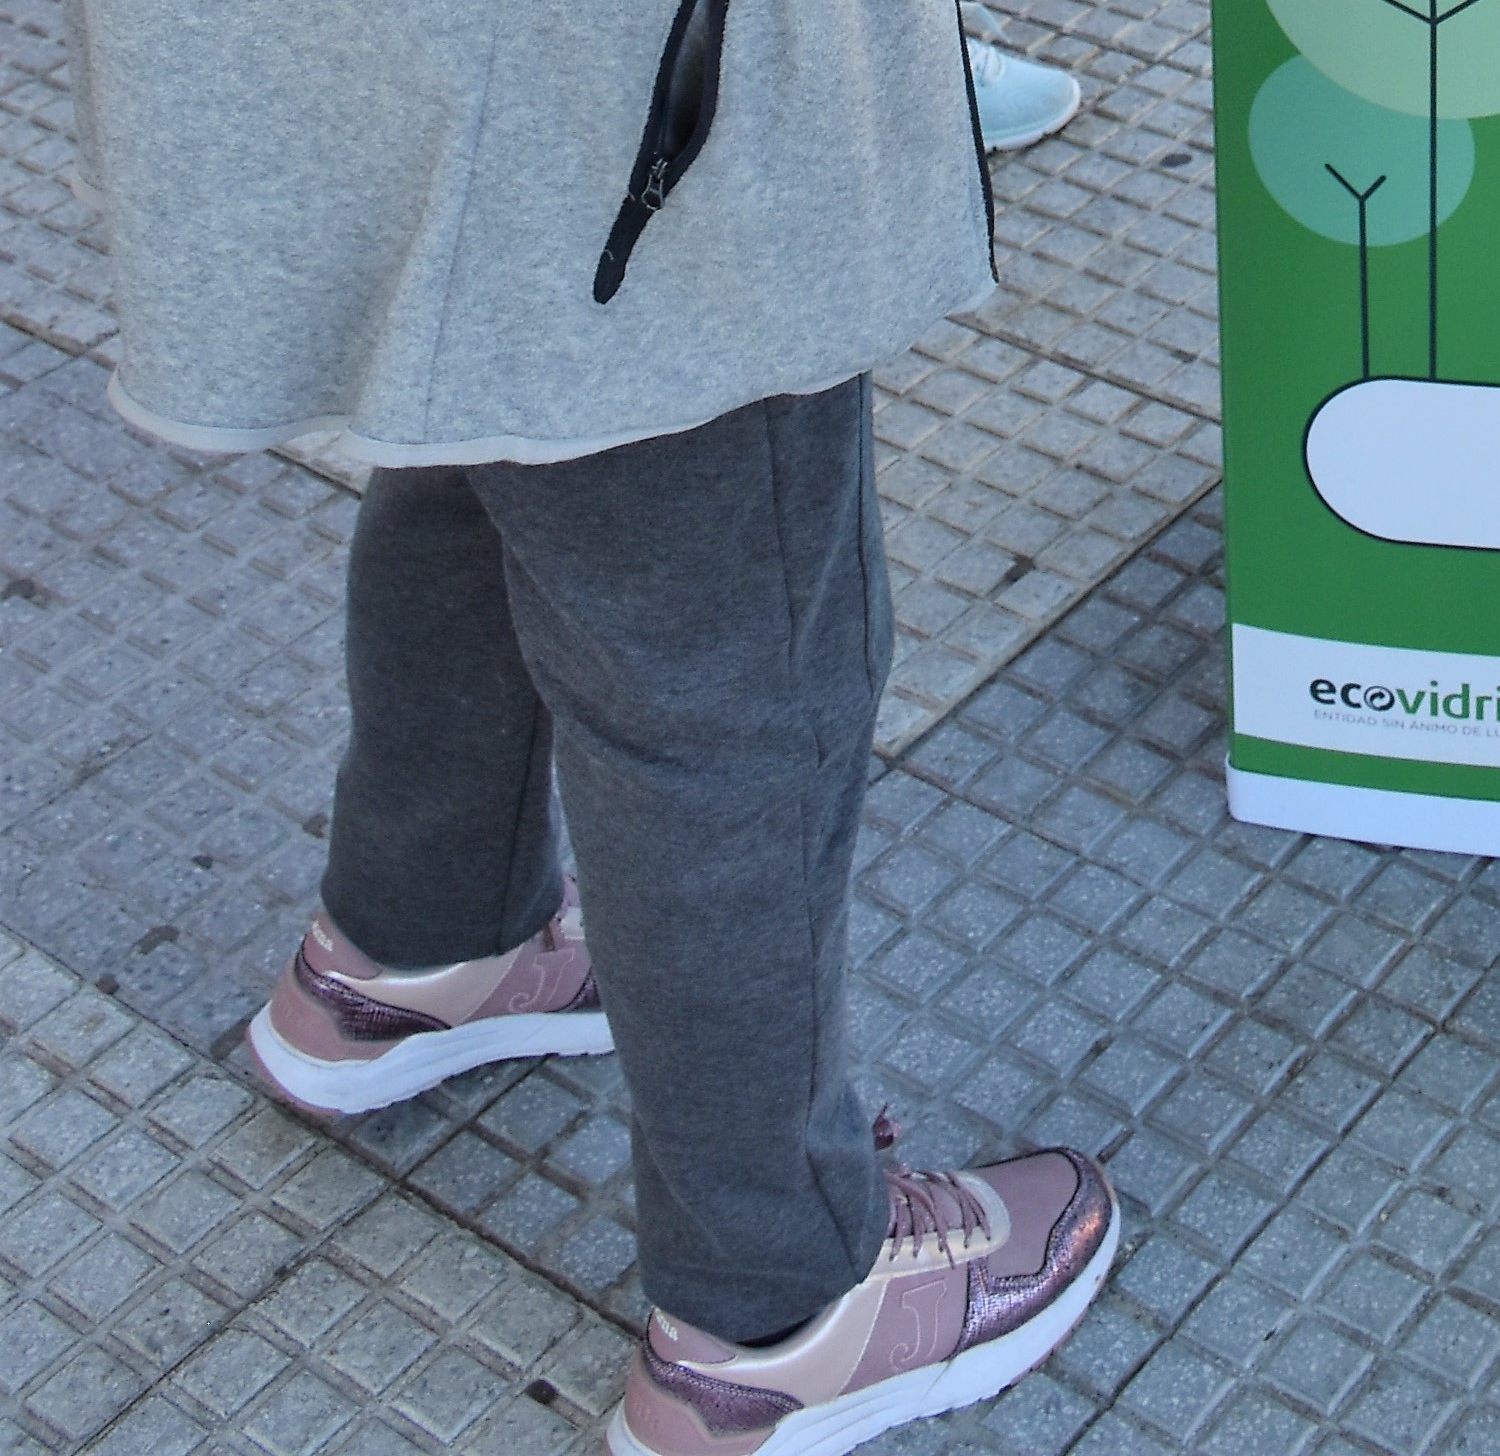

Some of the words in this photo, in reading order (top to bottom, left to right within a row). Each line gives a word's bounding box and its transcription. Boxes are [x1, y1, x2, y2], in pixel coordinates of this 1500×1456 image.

[1313, 708, 1378, 727] ENTIDAD
[1382, 717, 1406, 729] SIN
[1409, 718, 1458, 735] ÁNIMO
[1462, 725, 1482, 738] DE
